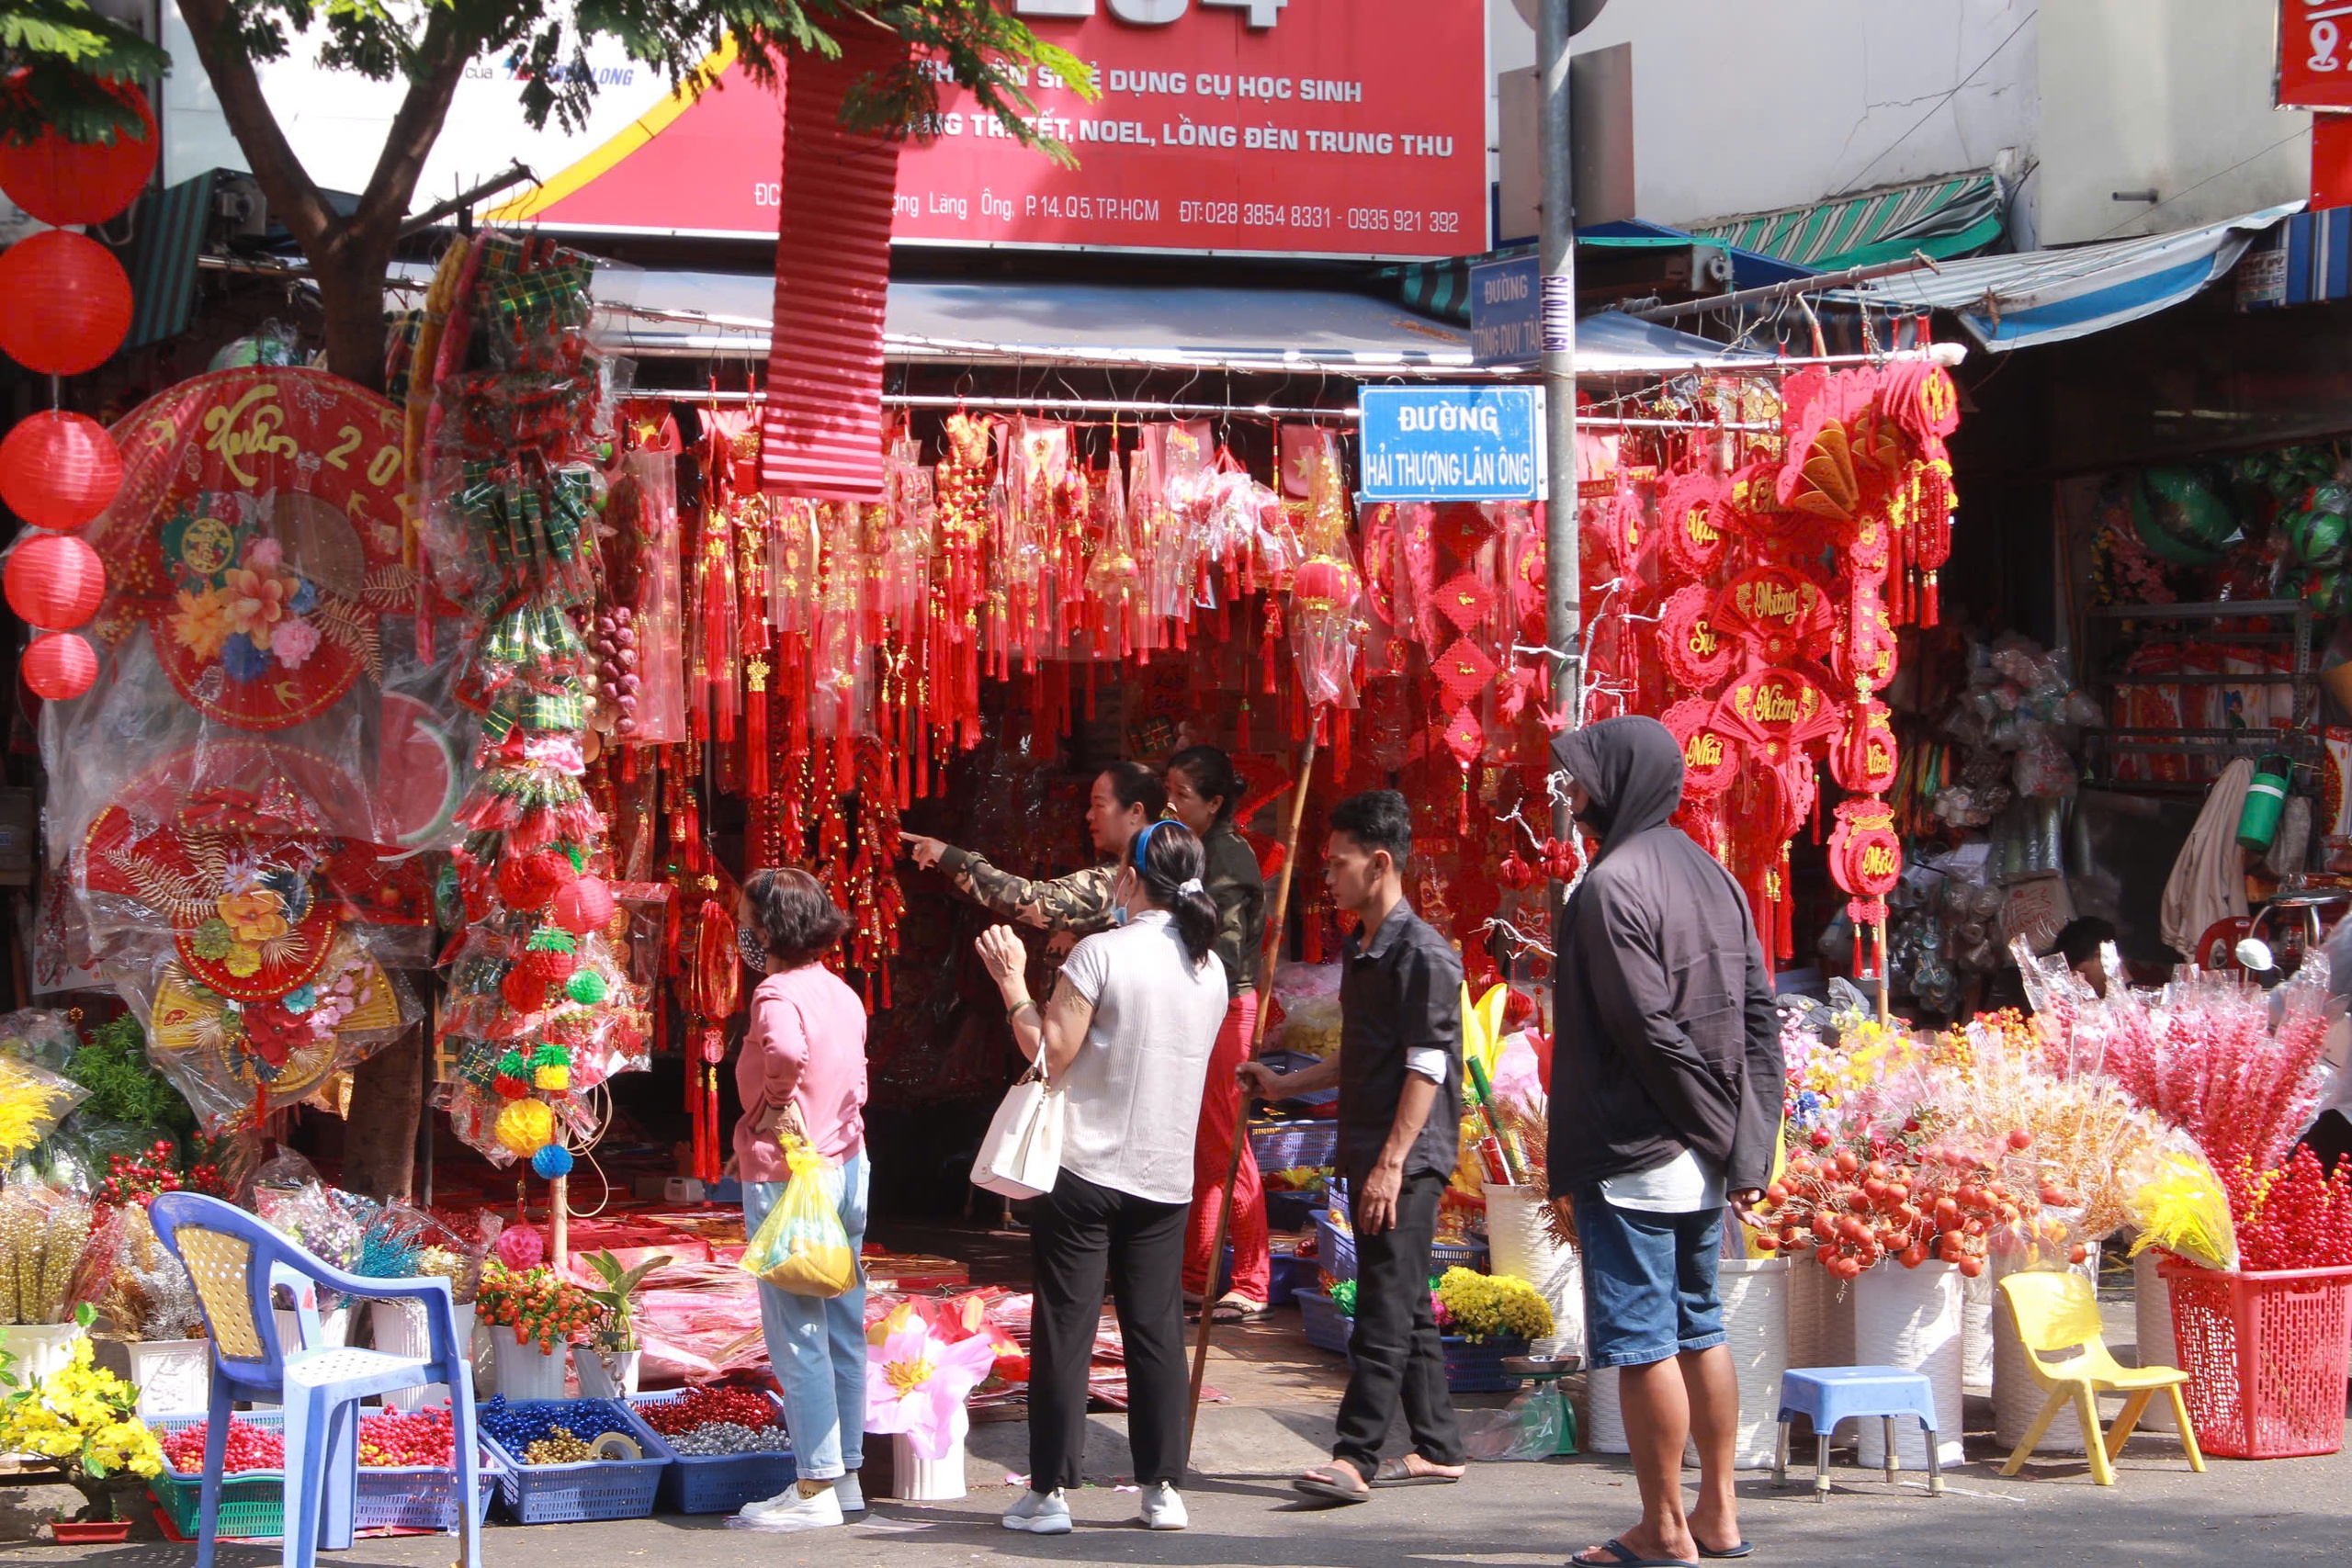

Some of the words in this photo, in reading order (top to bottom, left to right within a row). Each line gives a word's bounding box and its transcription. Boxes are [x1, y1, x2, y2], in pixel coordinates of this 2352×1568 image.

[1110, 69, 1186, 97] DỤNG
[1196, 73, 1231, 100] CỤ
[1238, 76, 1292, 103] HỌC
[1300, 79, 1362, 102] SINH
[1080, 119, 1156, 147] NOEL,
[1163, 114, 1237, 147] LỒNG
[1244, 121, 1298, 151] ĐÈN
[1306, 130, 1393, 154] TRUNG
[1400, 134, 1453, 157] THU
[929, 191, 967, 220] Lãng
[1243, 203, 1285, 226] 3854
[1291, 205, 1330, 228] 8331
[1348, 208, 1388, 230] 0935
[1394, 209, 1421, 231] 921
[1429, 211, 1459, 233] 392
[1485, 272, 1529, 305] ĐƯỜNG
[1501, 322, 1521, 355] DUY
[1397, 400, 1499, 432] ĐƯỜNG
[1366, 443, 1393, 487] HẢI
[1396, 450, 1459, 492] THƯỢNG
[1464, 446, 1495, 486] LÃN
[1498, 446, 1531, 487] ÔNG
